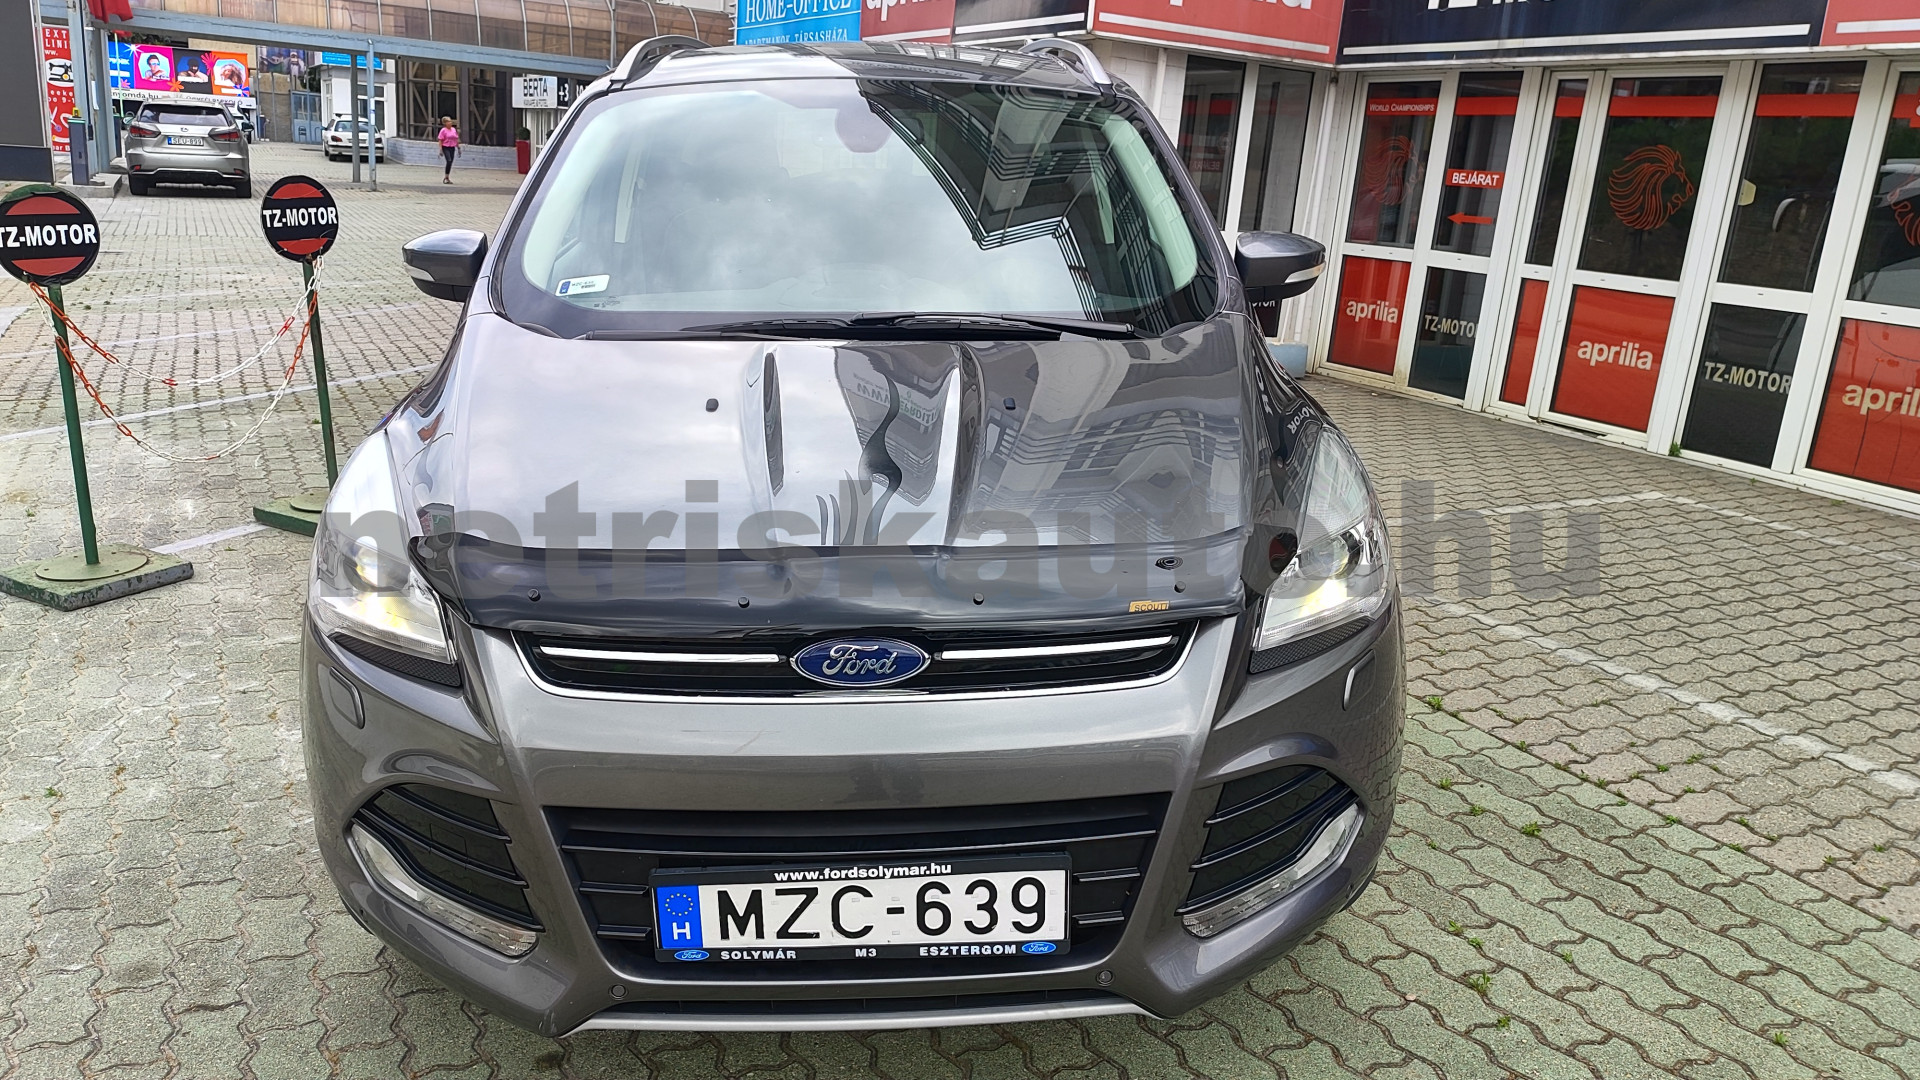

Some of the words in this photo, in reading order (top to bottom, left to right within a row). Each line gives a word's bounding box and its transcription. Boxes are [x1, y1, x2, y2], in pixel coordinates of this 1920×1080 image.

[523, 77, 549, 98] BERTA
[1390, 103, 1435, 112] CHAMPIONSHIPS
[1452, 171, 1500, 186] BEJÁRAT
[262, 207, 338, 228] TZ-MOTOR
[0, 223, 98, 248] TZ-MOTOR
[1346, 300, 1399, 324] aprilia
[1577, 340, 1654, 371] aprilia
[1704, 361, 1793, 395] TZ-MOTOR
[1842, 384, 1920, 418] april
[822, 644, 898, 676] Ford
[774, 863, 952, 882] www.fordsolymar.hu
[672, 922, 691, 940] H
[717, 876, 1046, 940] MZC-639
[720, 949, 797, 960] SOLYMÁR
[855, 948, 877, 957] M3
[919, 944, 1017, 956] ESZTERGOM
